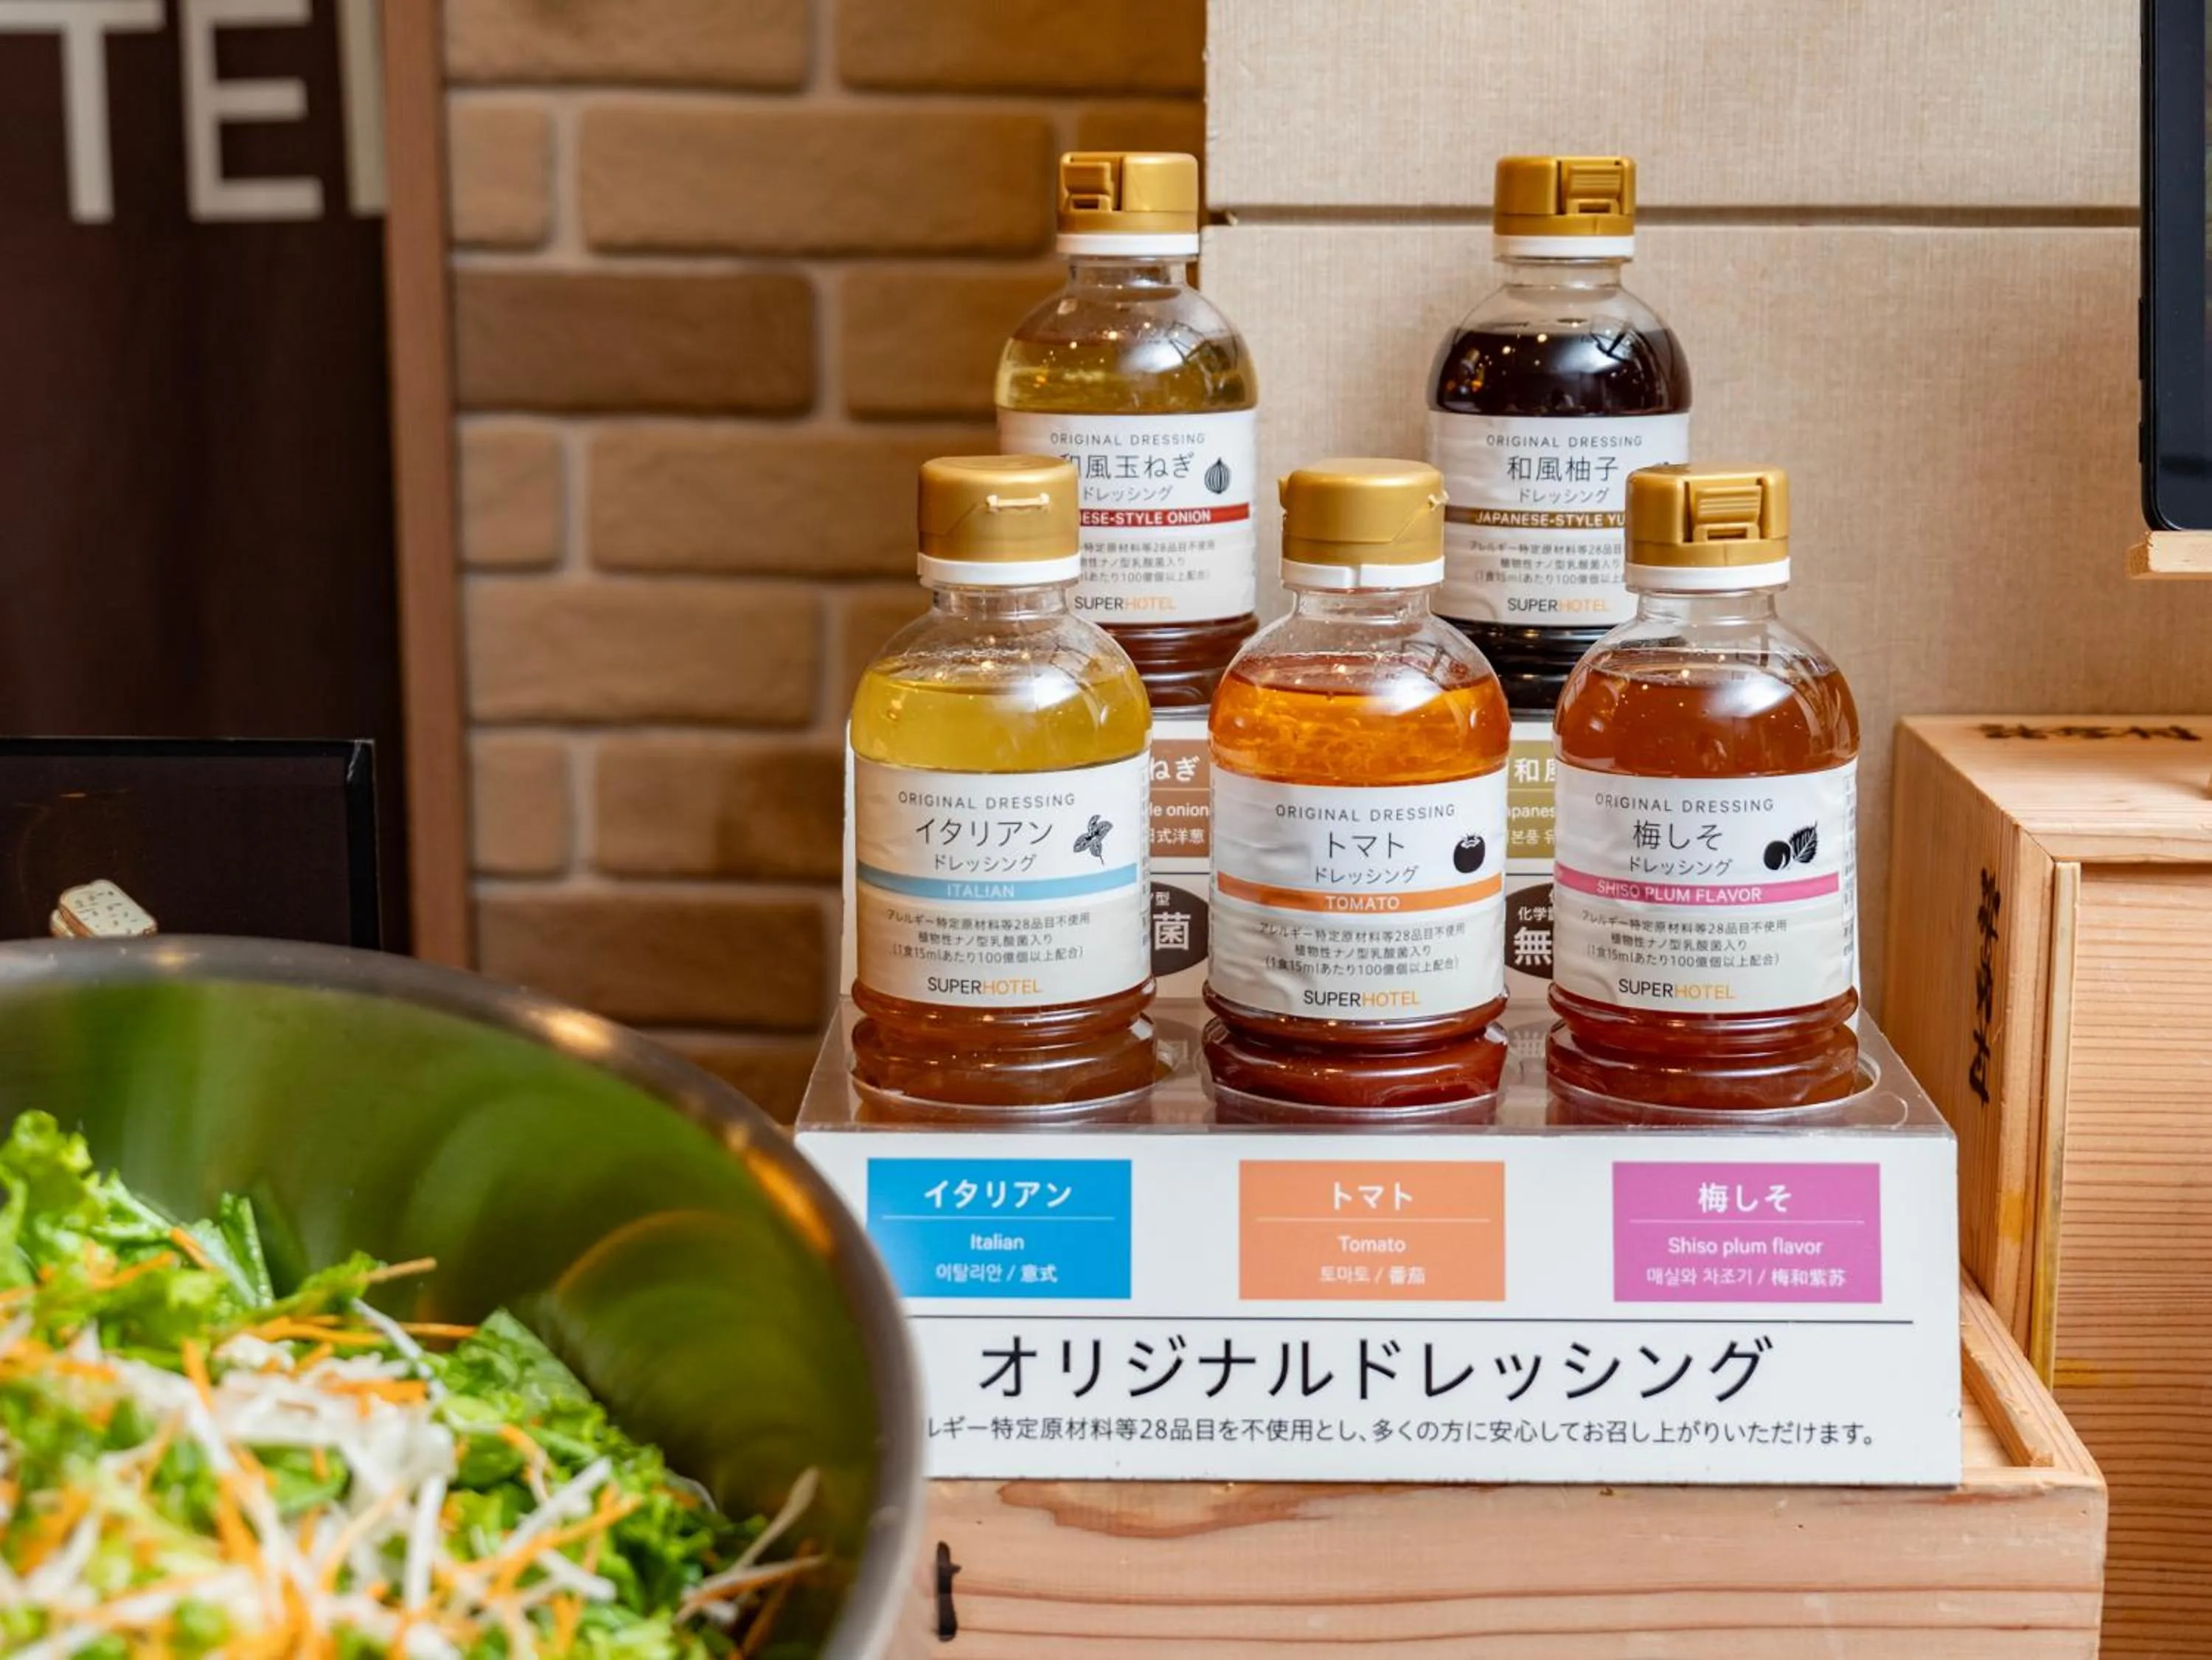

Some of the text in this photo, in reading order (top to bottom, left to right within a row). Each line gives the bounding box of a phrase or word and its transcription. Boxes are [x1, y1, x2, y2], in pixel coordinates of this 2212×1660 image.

[1050, 433, 1206, 446] ORIGINAL DRESSING
[1486, 434, 1643, 447] ORIGINAL DRESSING
[1507, 456, 1618, 482] 和風柚子
[1083, 485, 1174, 503] ドレッシング
[1520, 487, 1610, 504] ドレッシング
[1082, 510, 1211, 526] ESE-STYLE ONION
[1475, 512, 1625, 527] JAPANESE-STYLE YU
[1150, 755, 1200, 782] ねぎ
[898, 791, 1075, 809] ORIGINAL DRESSING
[1150, 801, 1209, 817] le onion
[1595, 792, 1774, 813] ORIGINAL DRESSING
[1276, 803, 1455, 822] ORIGINAL DRESSING
[1508, 806, 1555, 822] panes
[916, 817, 1053, 847] イタリアン
[1632, 818, 1723, 851] 梅しそ
[1328, 831, 1405, 859] トマト
[933, 854, 1037, 873] ドレッシング
[1629, 855, 1733, 876] ドレッシング
[1315, 865, 1419, 885] ドレッシング
[947, 883, 1015, 899] ITALIAN
[1596, 879, 1763, 902] SHISO PLUM FLAVOR
[1325, 895, 1399, 910] TOMATO
[1152, 912, 1191, 951] 菌
[1514, 926, 1552, 966] 無
[927, 977, 1043, 995] SUPERHOTEL
[1618, 979, 1736, 1000] SUPERHOTEL
[1303, 990, 1420, 1007] SUPERHOTEL
[924, 1179, 1072, 1209] イタリアン
[1333, 1182, 1413, 1211] トマト
[1698, 1182, 1792, 1213] 梅しそ
[970, 1233, 1025, 1251] Italian
[1337, 1235, 1406, 1253] Tomato
[1668, 1237, 1823, 1258] Shiso plum flavor
[936, 1263, 1003, 1283] 이탈리안
[1319, 1266, 1371, 1283] 토마토
[1646, 1267, 1697, 1286] 매실와
[1703, 1267, 1753, 1286] 차조기
[979, 1334, 1774, 1402] オリジナルドレッシング
[928, 1416, 1874, 1446] ルギー特定原材料等28品目を不使用とし、多くの方に安心してお召し上がりいただけます。
